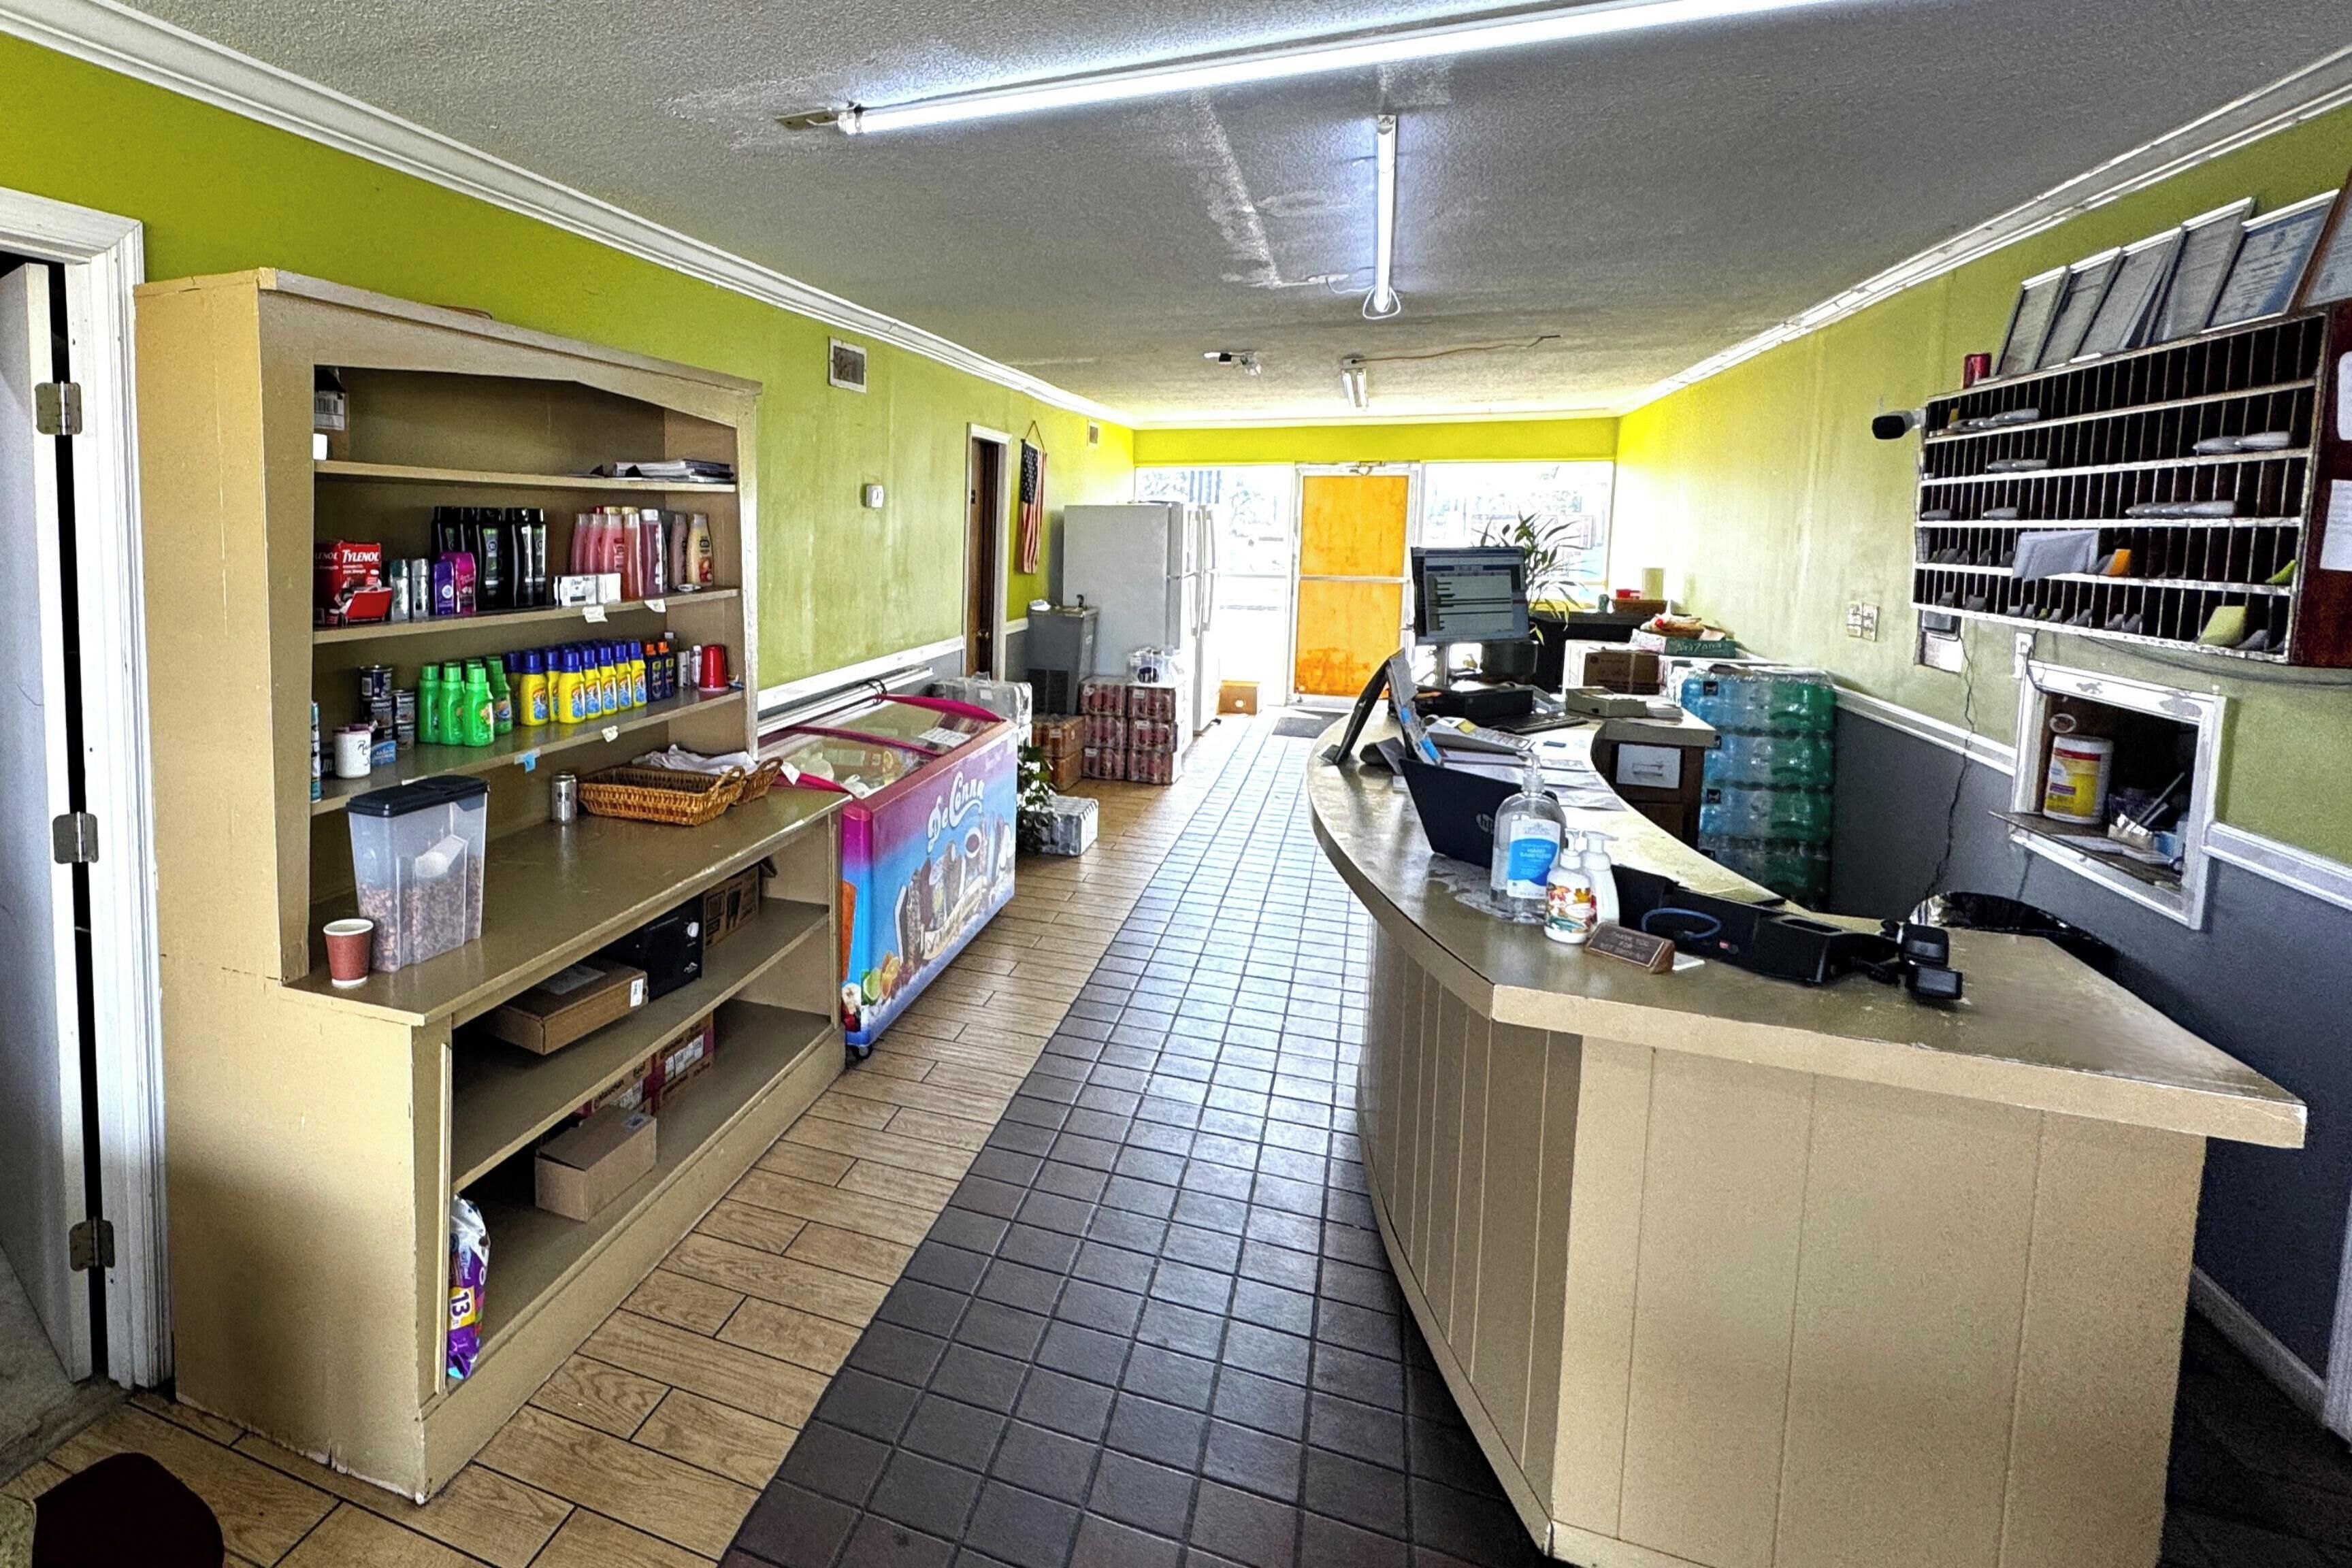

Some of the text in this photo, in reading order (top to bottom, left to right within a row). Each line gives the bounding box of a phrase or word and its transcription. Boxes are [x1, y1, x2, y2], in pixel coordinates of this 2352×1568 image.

[315, 551, 338, 560] LENOL
[342, 549, 380, 564] TYLENOL
[451, 1292, 471, 1317] 13
